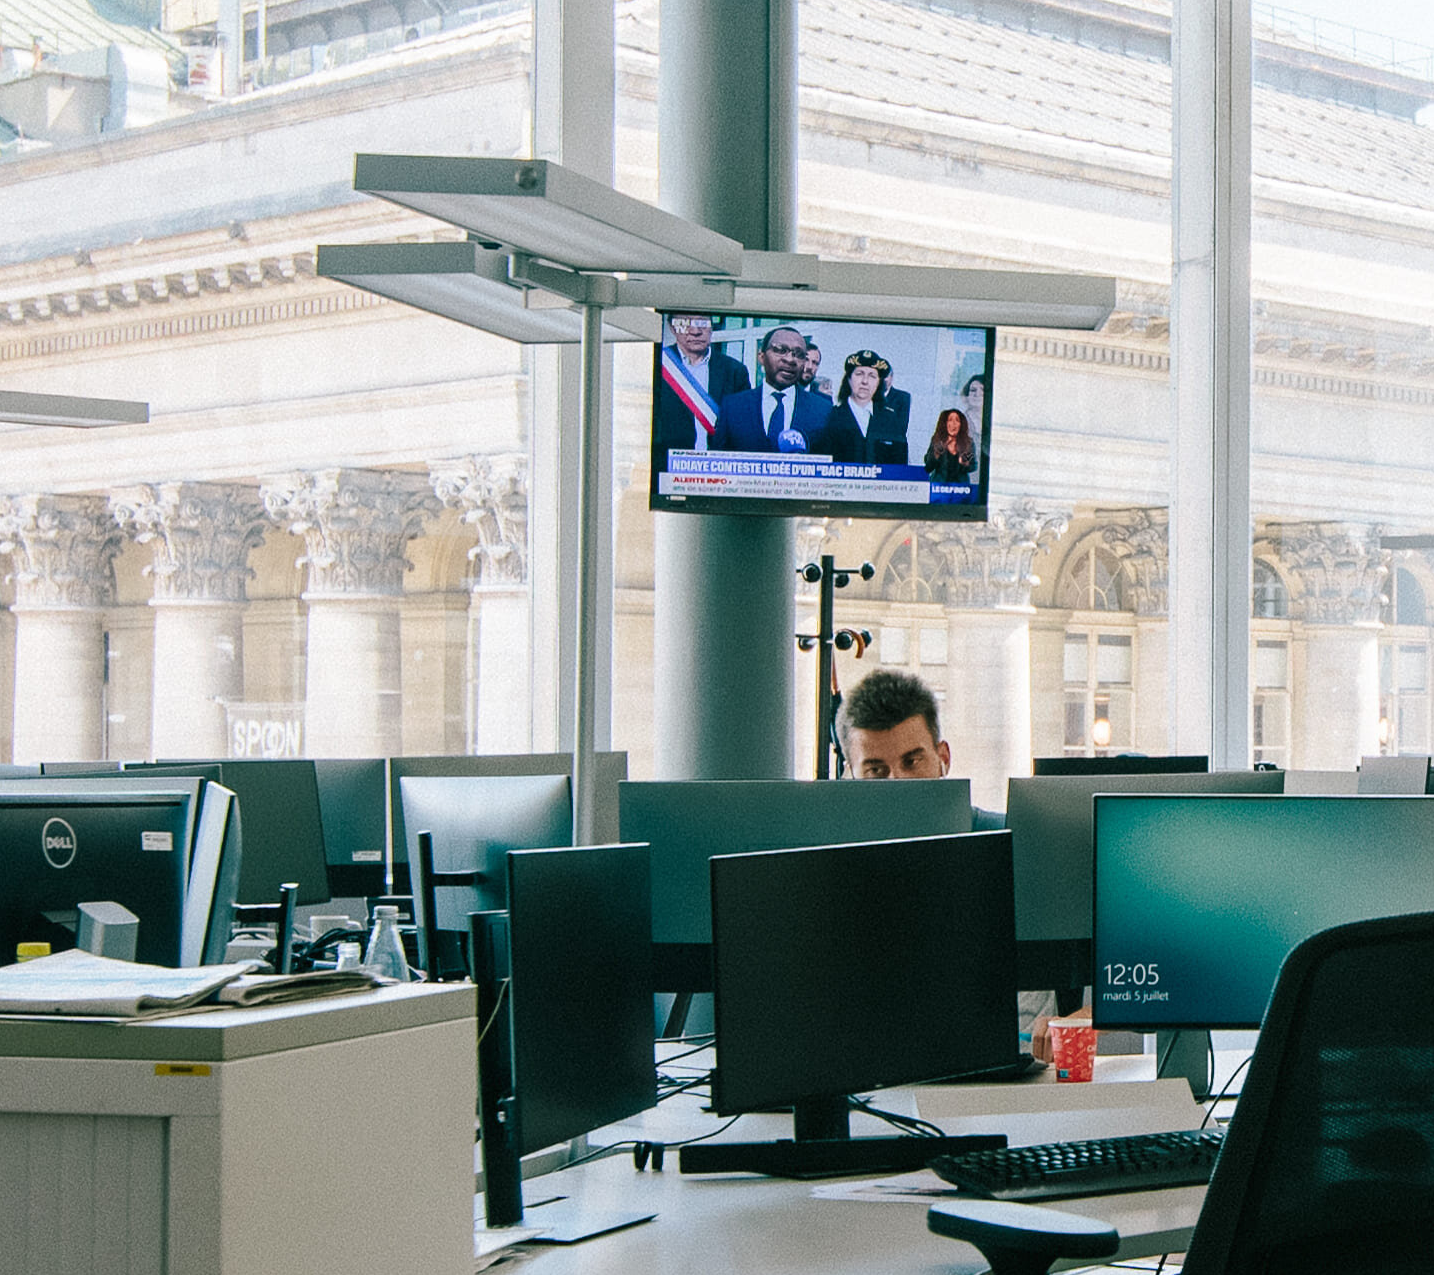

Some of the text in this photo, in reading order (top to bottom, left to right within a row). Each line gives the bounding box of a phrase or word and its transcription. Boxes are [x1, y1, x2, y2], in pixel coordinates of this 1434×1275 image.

[672, 459, 710, 472] NDIAYE
[711, 460, 761, 474] CONTESTE
[762, 461, 790, 475] L'IDÉE
[792, 464, 815, 476] D'UN
[844, 464, 882, 478] BRADÉ"
[673, 476, 705, 484] ALERTE
[707, 477, 727, 485] INFO
[46, 836, 73, 849] DELL
[1104, 963, 1160, 985] 12:05
[1103, 990, 1169, 1004] mardi 5 juillet
